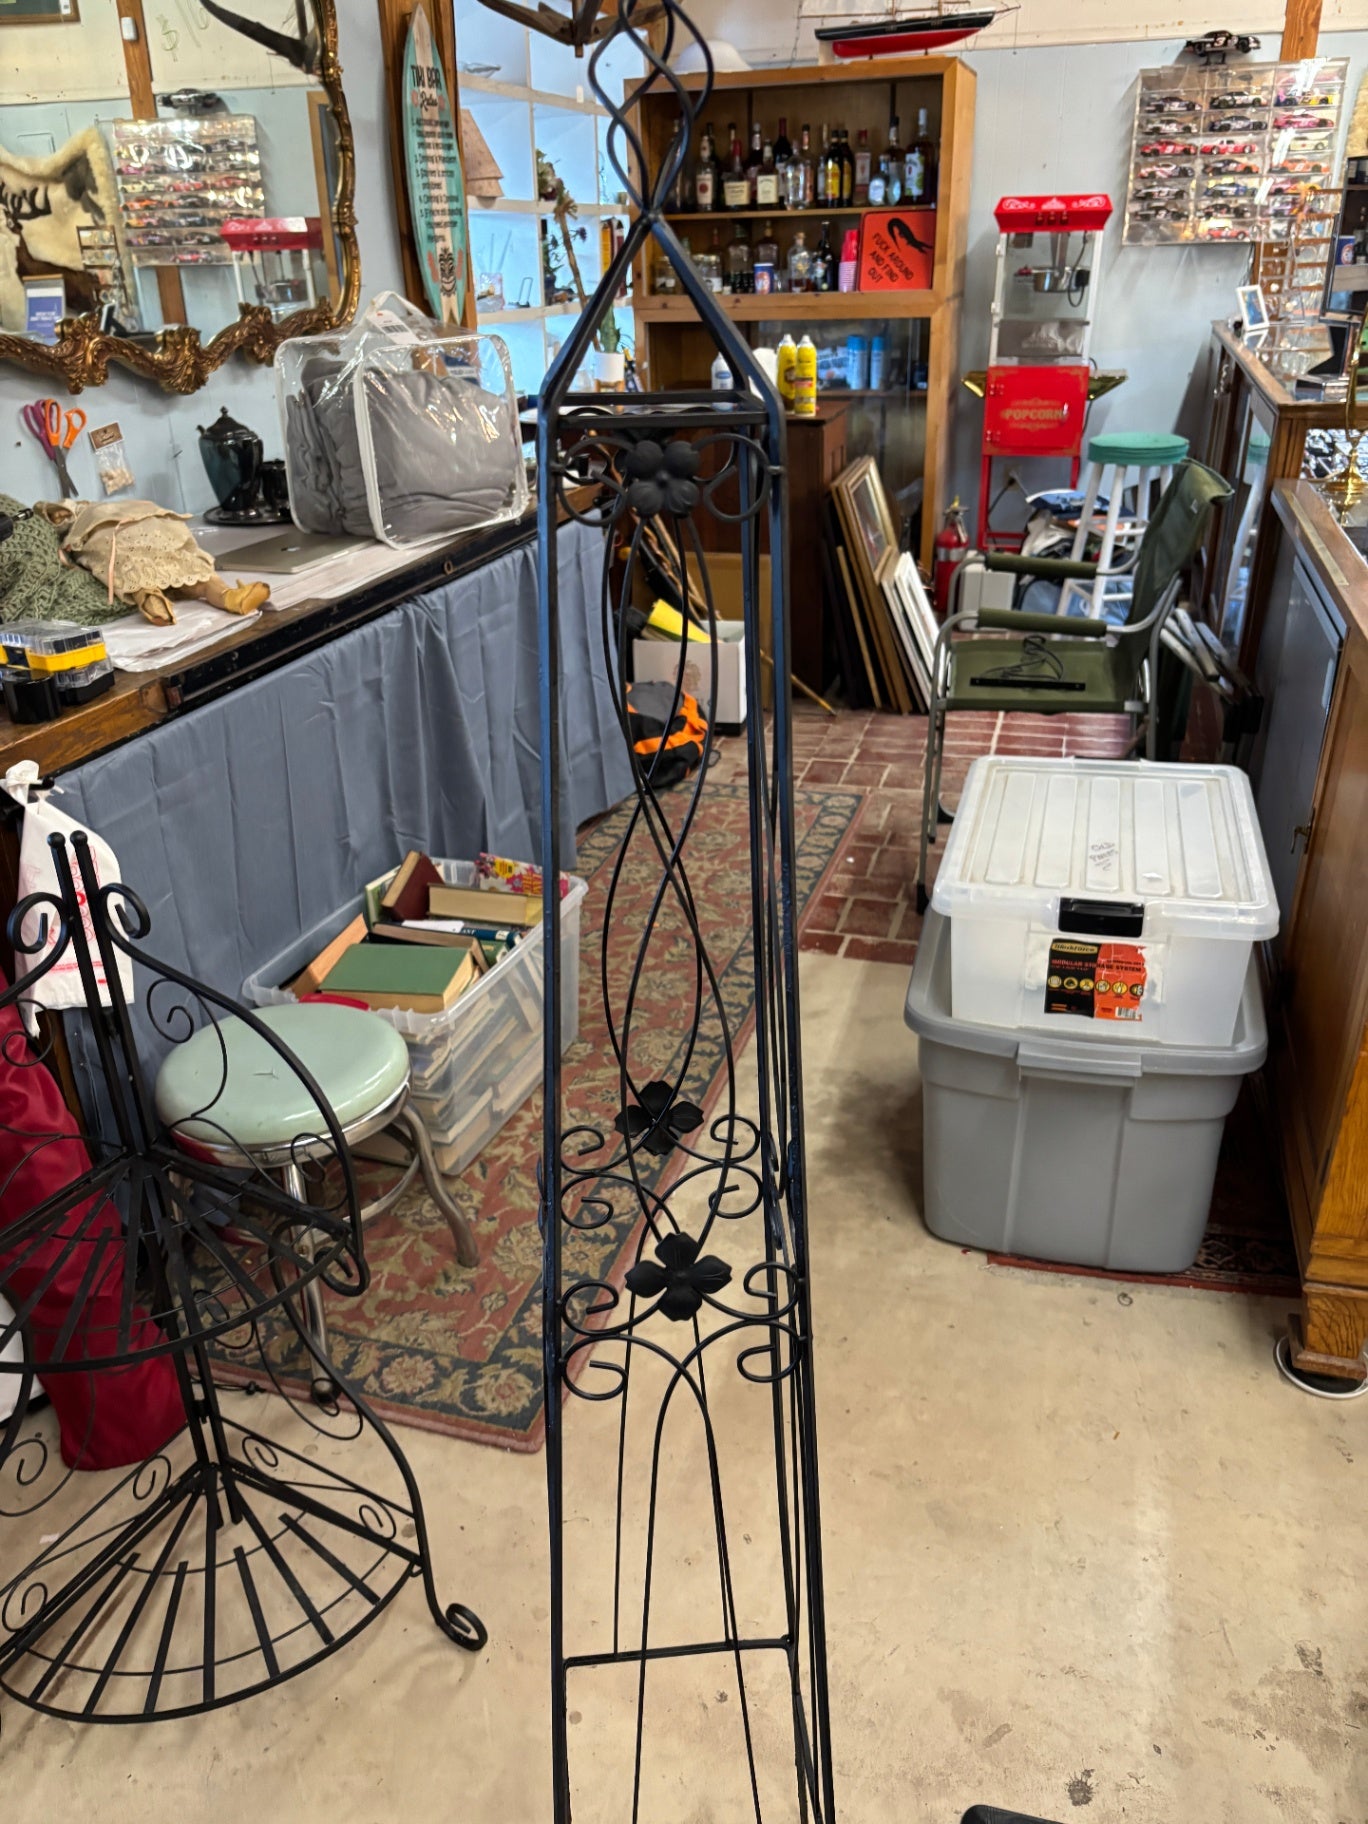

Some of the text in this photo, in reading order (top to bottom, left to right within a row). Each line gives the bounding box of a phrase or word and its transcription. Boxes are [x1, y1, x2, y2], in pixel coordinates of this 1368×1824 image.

[411, 65, 442, 90] TIKI BAR
[870, 250, 899, 282] AND FIND
[872, 233, 914, 280] FUCK AROUND
[868, 267, 884, 283] OUT
[1002, 409, 1066, 420] POPCORN
[1115, 964, 1142, 972] SYSTEM
